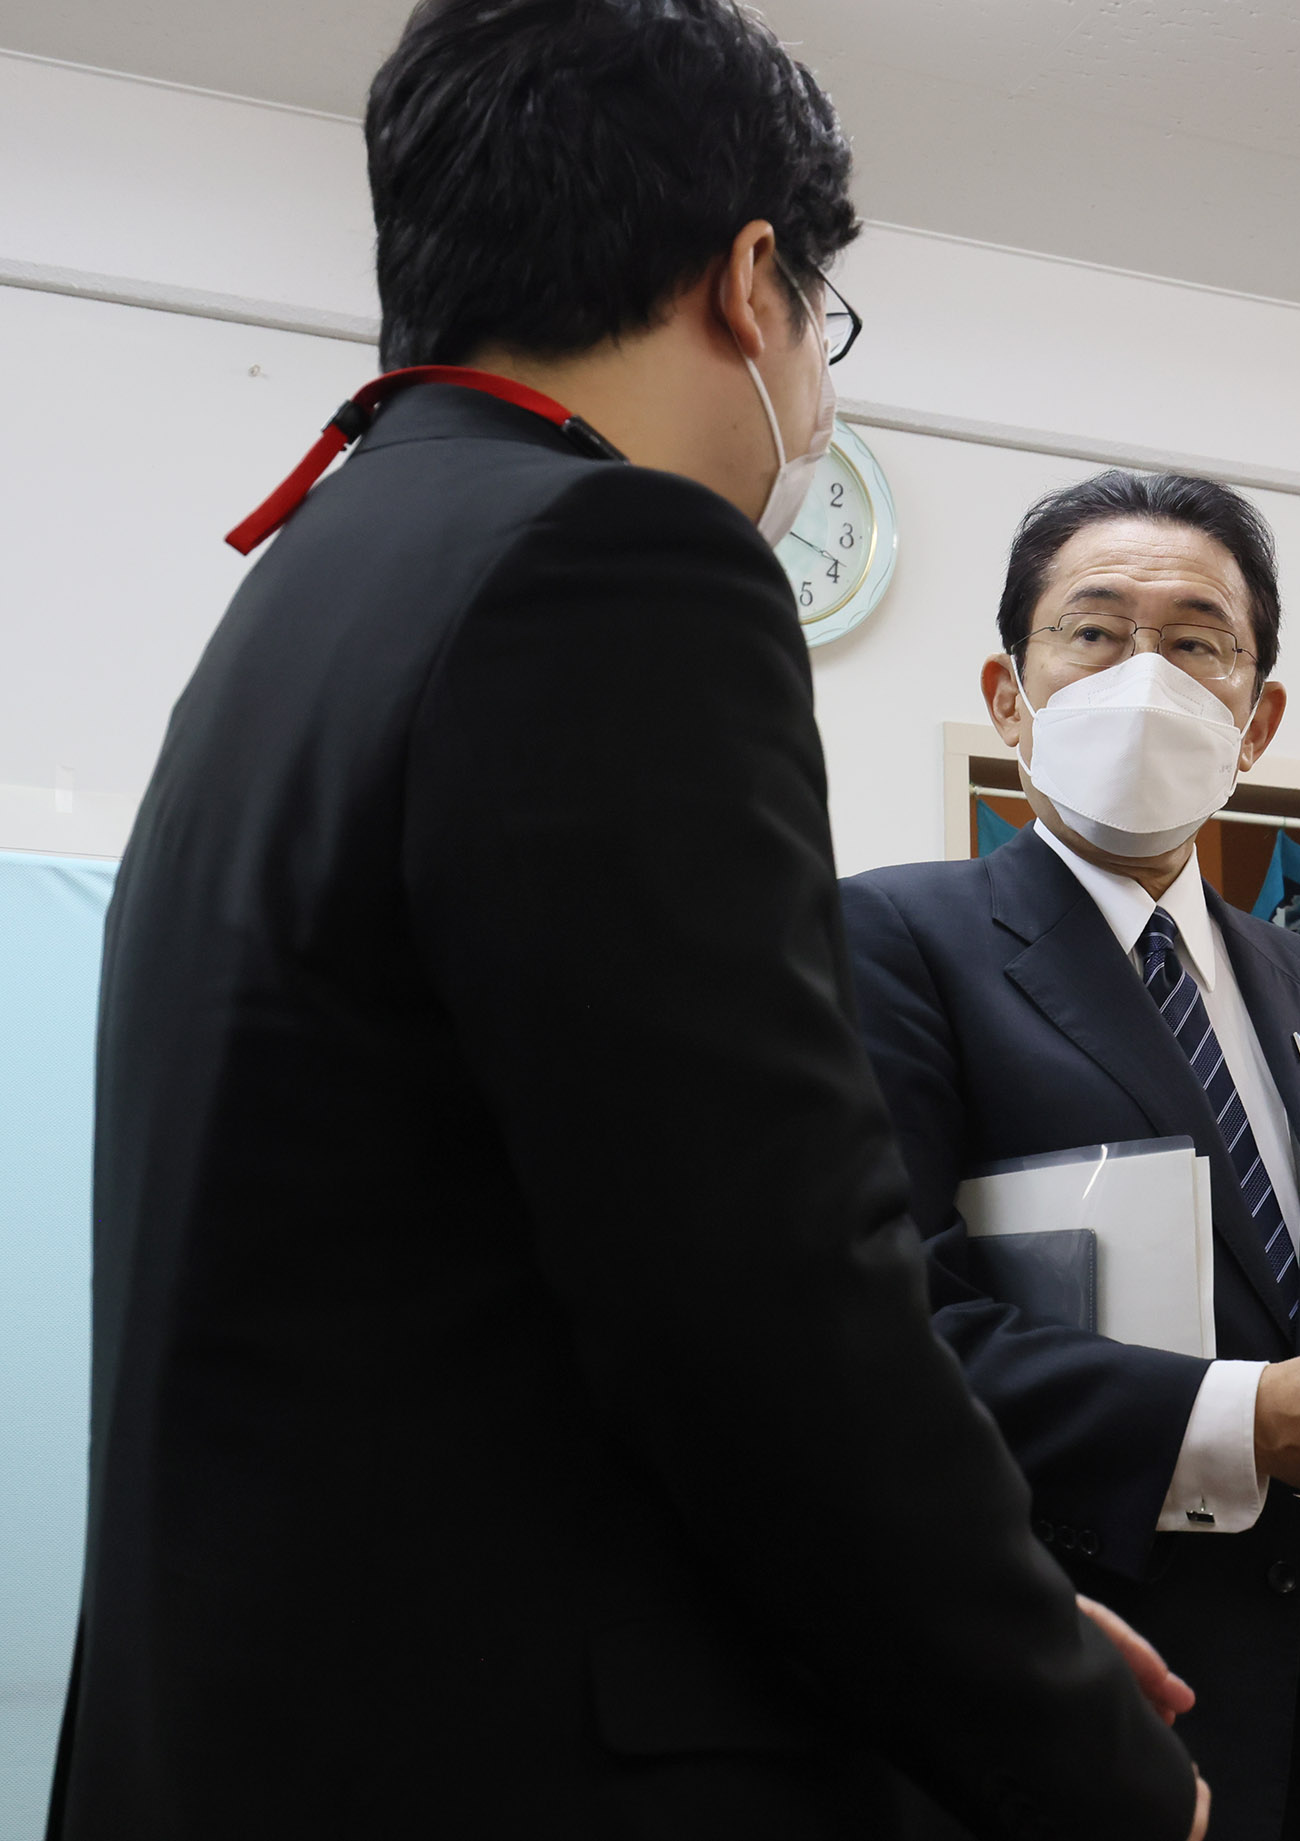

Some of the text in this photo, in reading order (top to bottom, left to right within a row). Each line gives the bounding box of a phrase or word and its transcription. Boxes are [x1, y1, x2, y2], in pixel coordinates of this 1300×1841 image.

[830, 483, 844, 508] 2
[839, 523, 854, 549] 3
[826, 559, 841, 584] 4
[800, 581, 813, 607] 5
